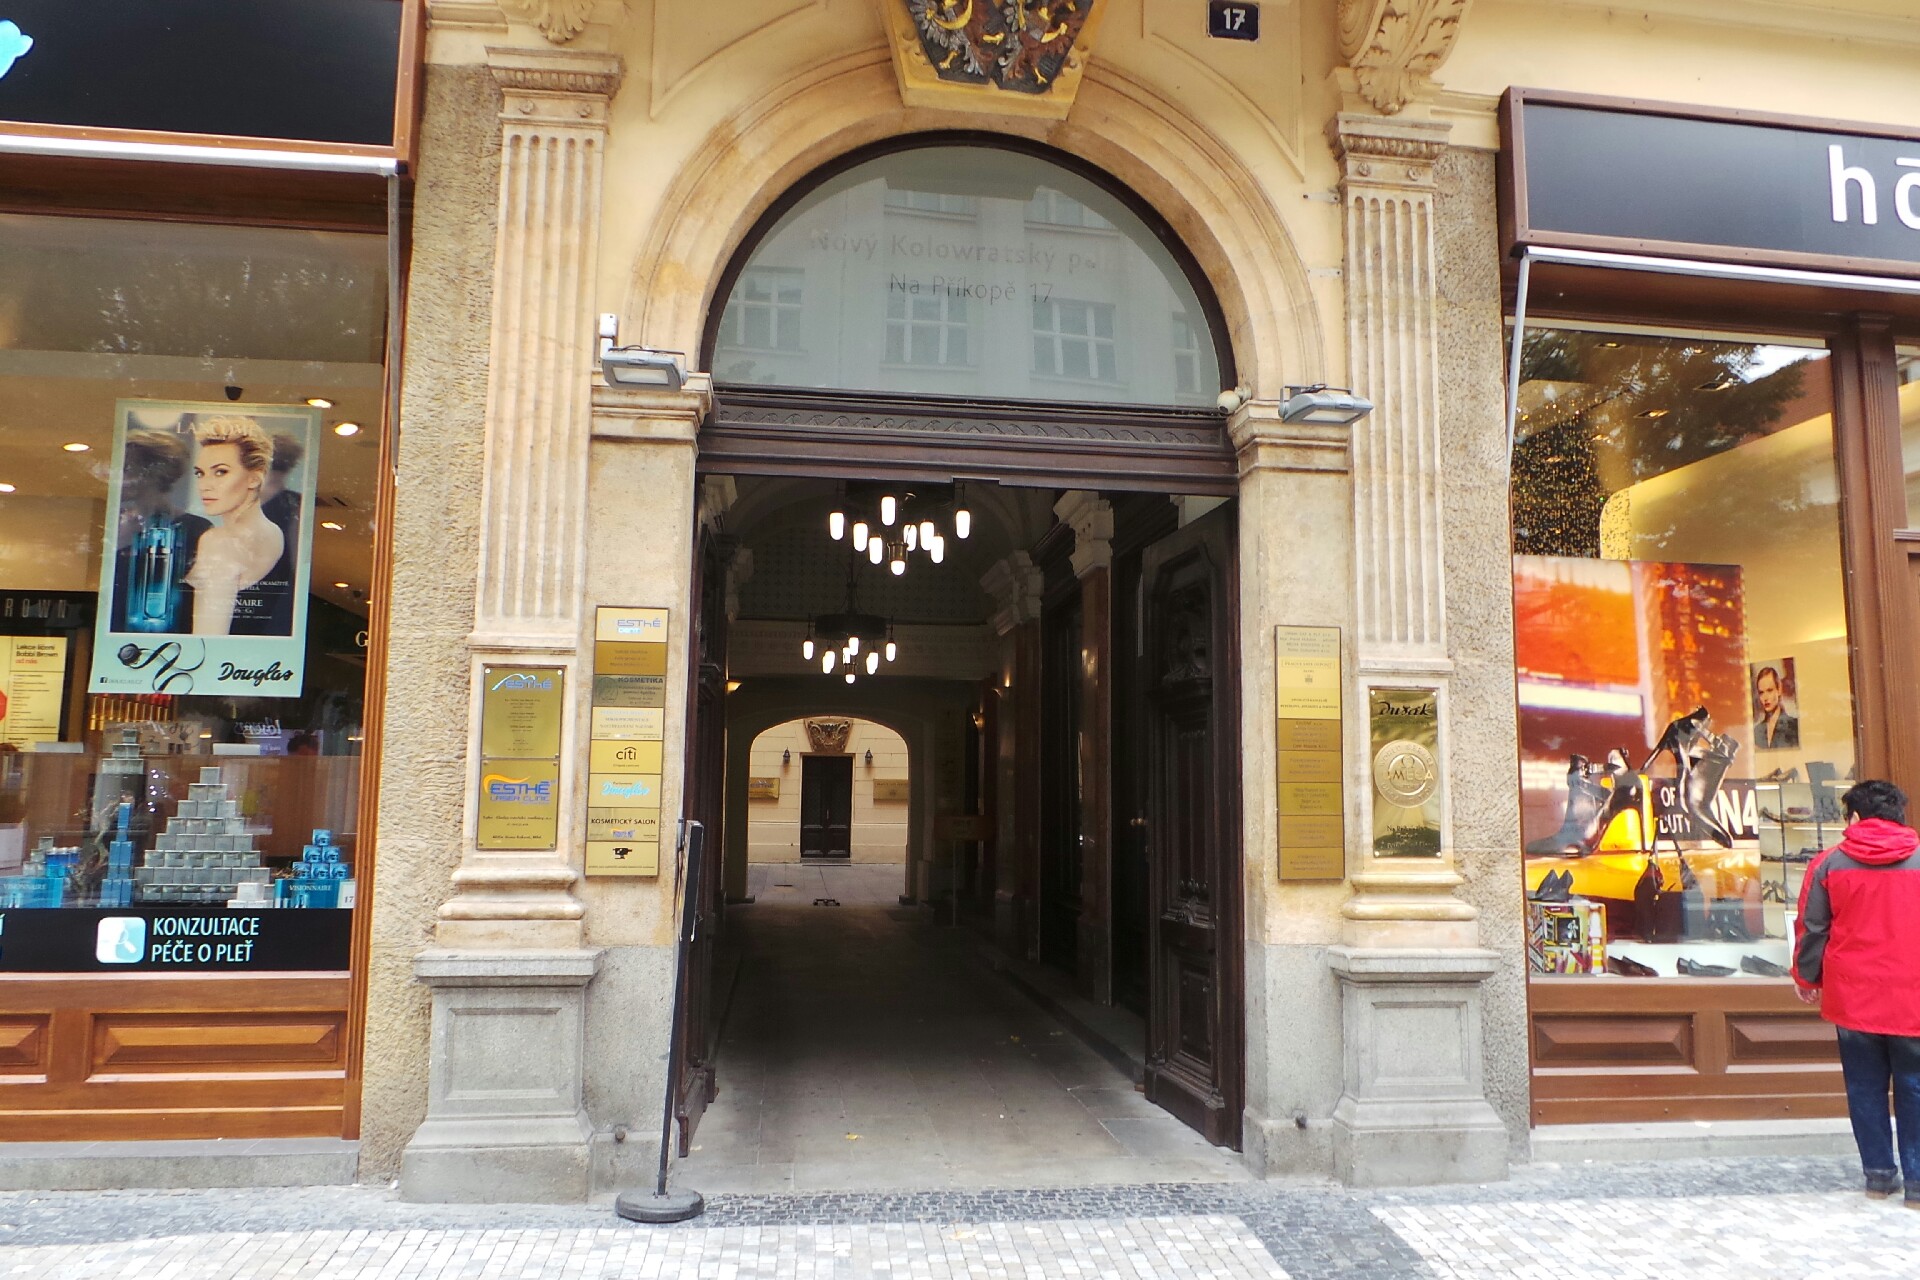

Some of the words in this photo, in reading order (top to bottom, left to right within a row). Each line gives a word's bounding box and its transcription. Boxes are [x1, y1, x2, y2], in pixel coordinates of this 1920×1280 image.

[1223, 8, 1246, 30] 17
[890, 234, 1055, 273] Kolowratský
[890, 273, 920, 294] Na
[933, 275, 1016, 306] Příkopě
[1030, 282, 1054, 303] 17
[217, 661, 294, 687] Douglas
[616, 747, 637, 760] citi
[591, 817, 632, 825] KOSMETICKÝ
[153, 917, 260, 936] KONZULTACE
[151, 939, 194, 962] PÉČE
[197, 943, 212, 962] O
[216, 939, 253, 962] PLEŤ
